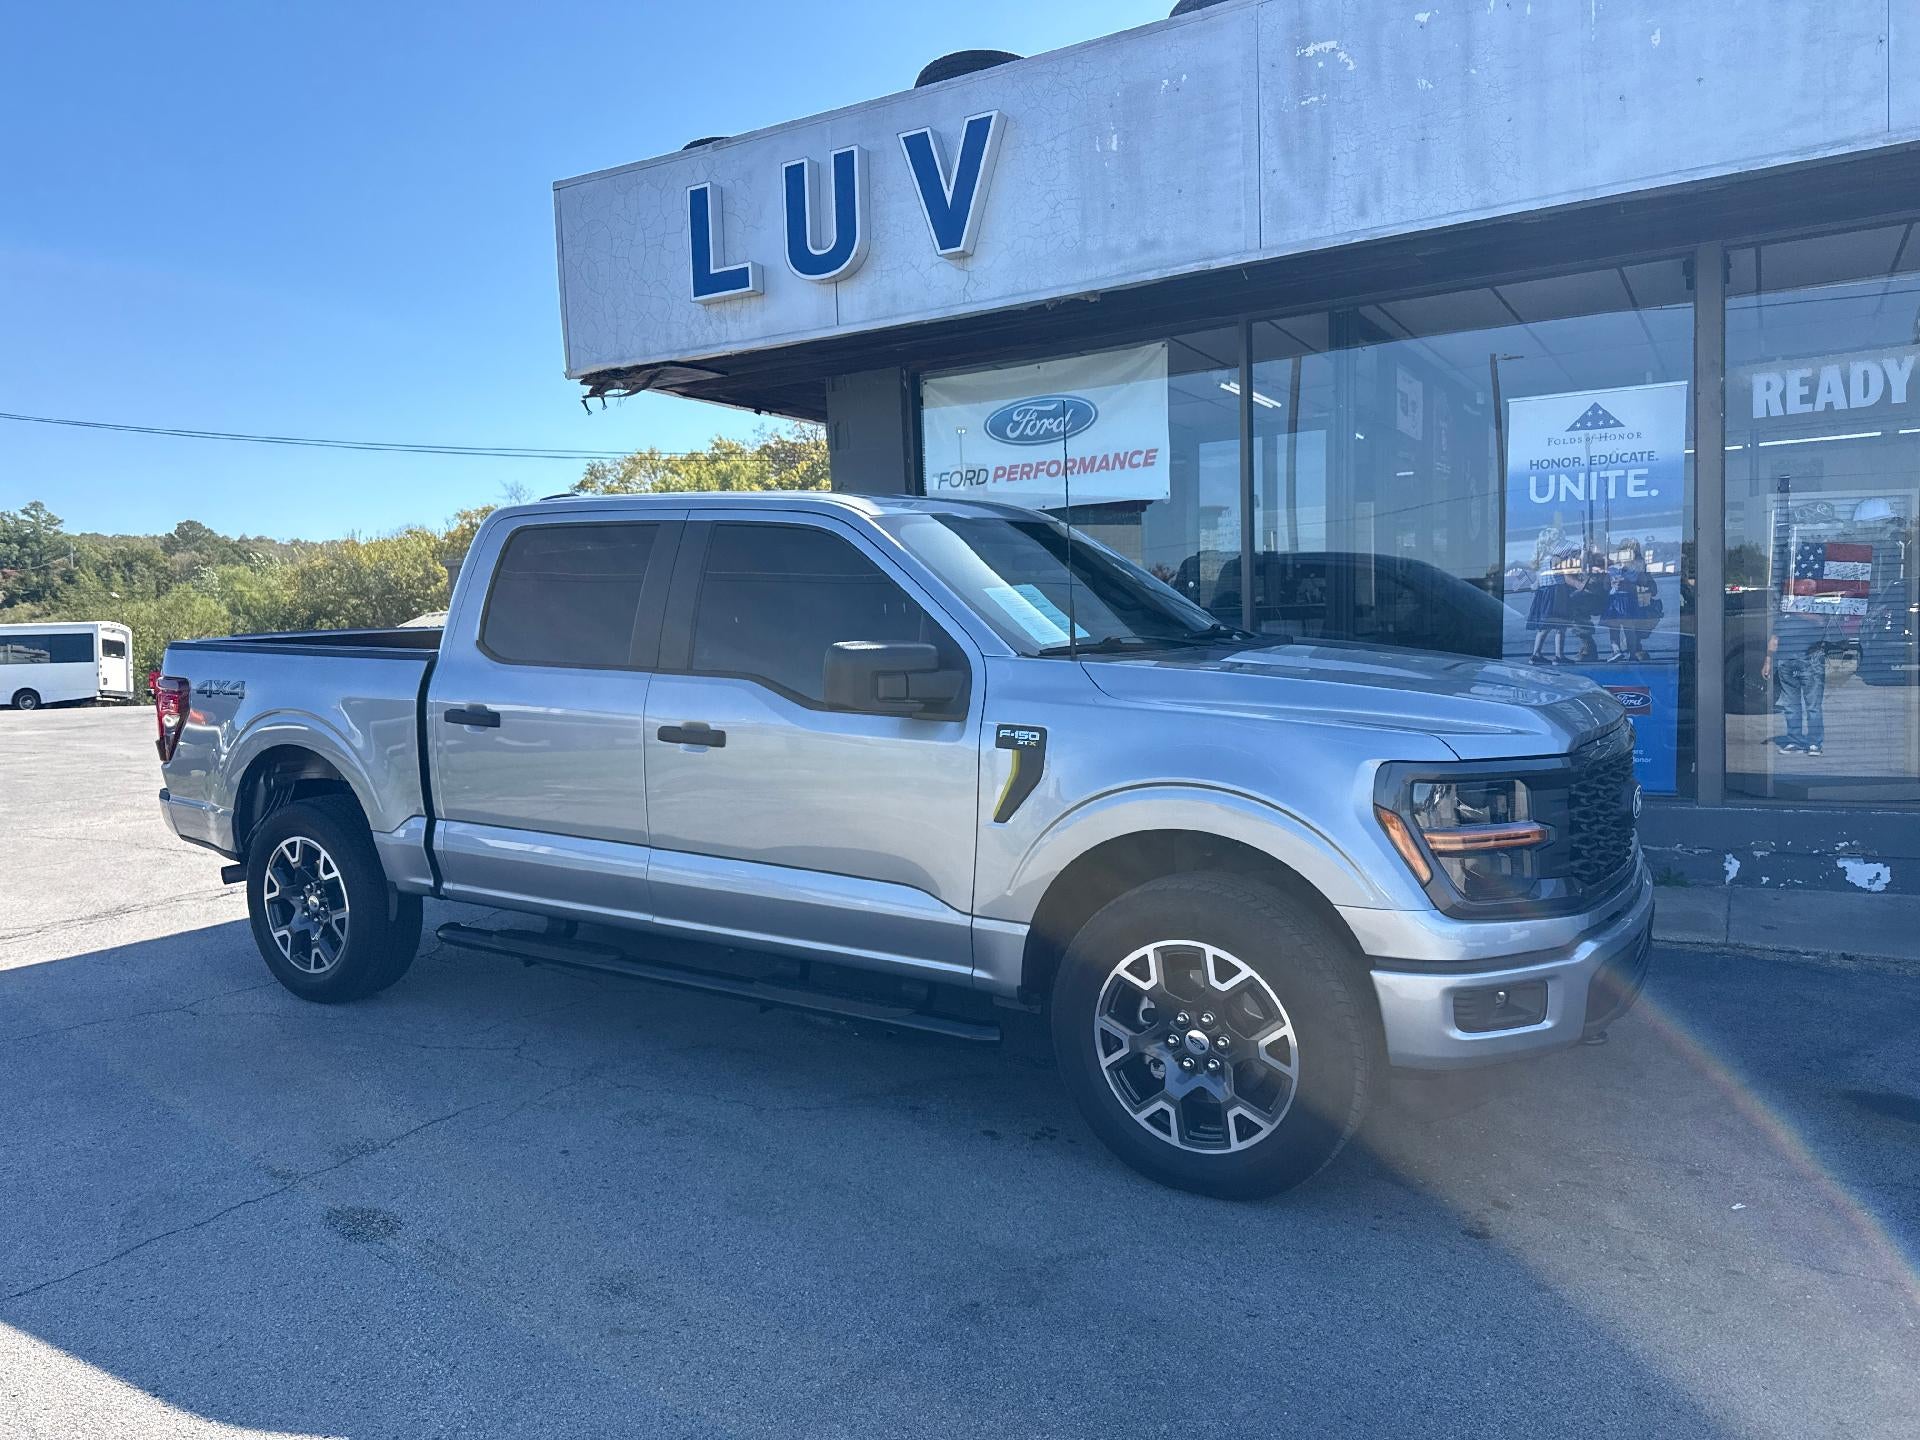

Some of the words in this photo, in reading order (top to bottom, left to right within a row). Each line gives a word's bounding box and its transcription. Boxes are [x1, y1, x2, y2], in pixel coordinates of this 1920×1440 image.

[686, 109, 1008, 304] LUV
[1752, 355, 1916, 418] READY
[1006, 401, 1073, 438] Ford
[1547, 436, 1582, 446] FOLDS
[1599, 431, 1642, 442] HONOR
[937, 467, 989, 490] FORD
[993, 447, 1160, 484] PERFORMANCE
[1529, 457, 1585, 470] HONOR.
[1589, 450, 1659, 465] EDUCATE.
[1529, 468, 1659, 504] UNITE.
[999, 729, 1040, 741] F-150
